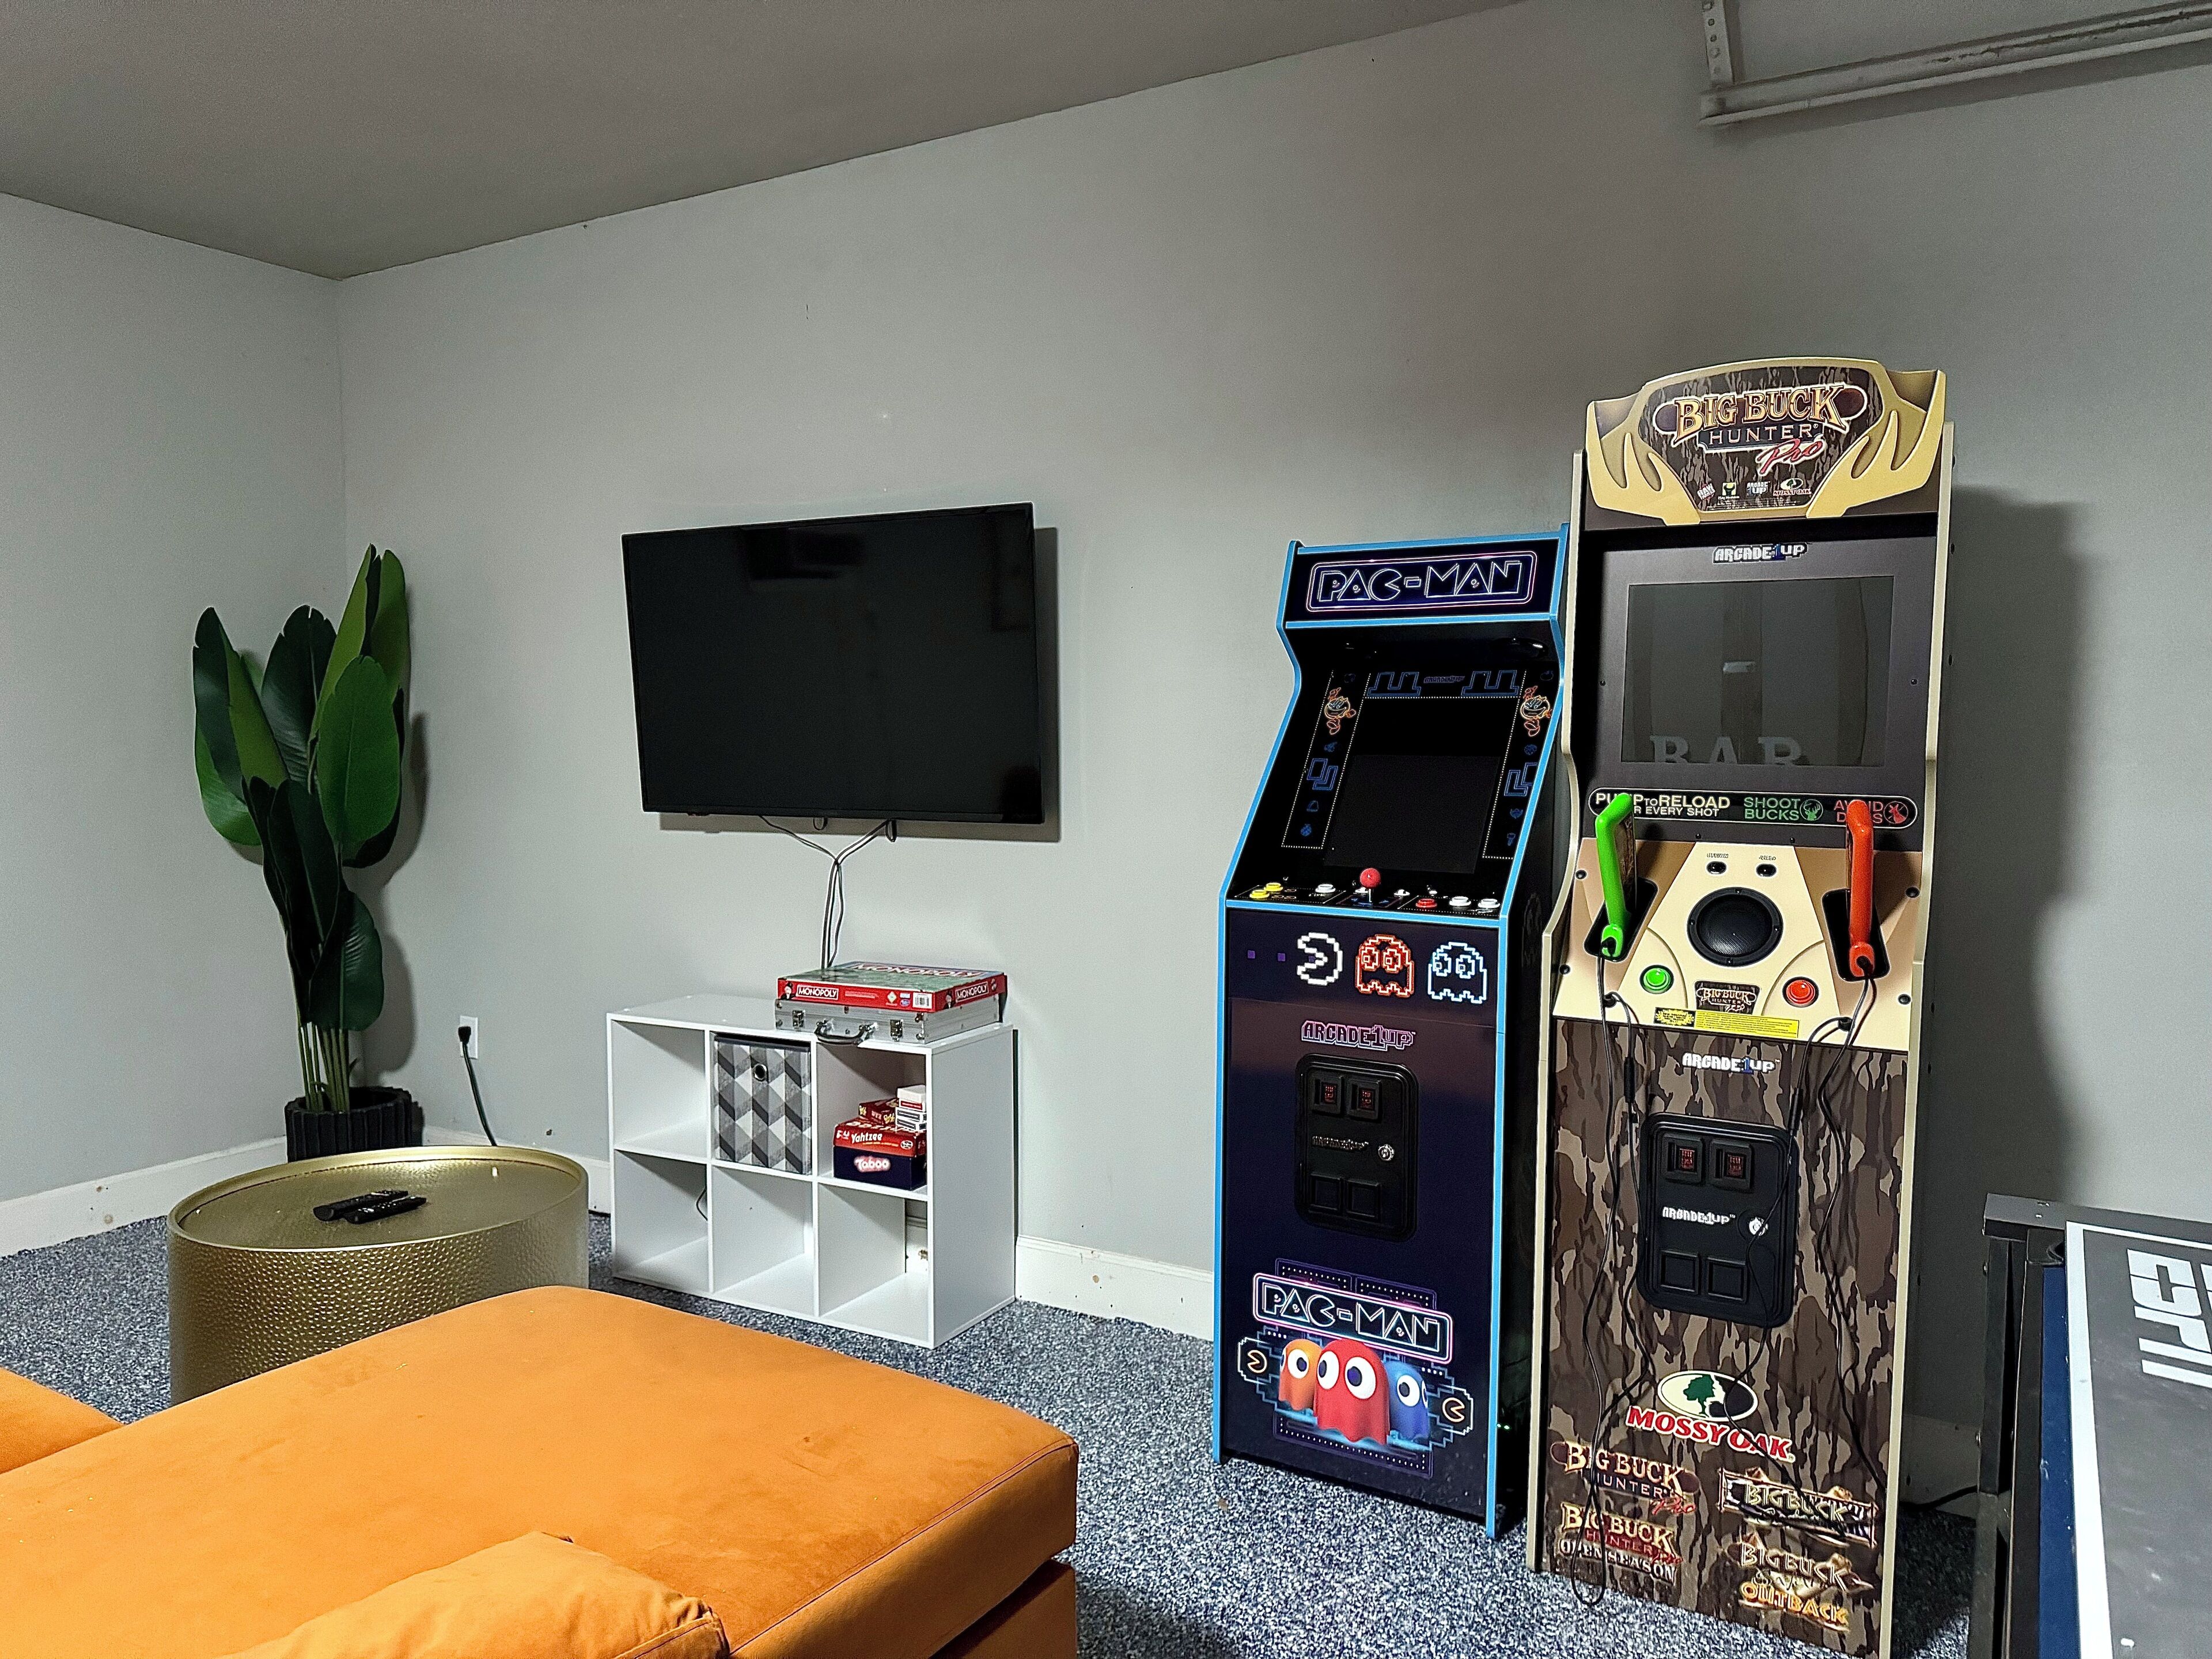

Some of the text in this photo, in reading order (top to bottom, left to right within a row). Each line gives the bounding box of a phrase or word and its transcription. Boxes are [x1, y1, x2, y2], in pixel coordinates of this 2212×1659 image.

[1673, 385, 1847, 444] BIG BUCK
[1709, 424, 1813, 445] HUNTER
[1758, 438, 1825, 475] Pro
[1317, 560, 1523, 602] PAC-MAN
[1659, 794, 1730, 809] RELOAD
[1744, 797, 1800, 809] SHOOT
[1646, 806, 1683, 816] EVERY
[1687, 808, 1719, 817] SHOT
[1745, 809, 1799, 820] BUCKS
[1836, 812, 1883, 823] DS
[853, 964, 986, 977] MONOPOLY
[798, 986, 838, 999] MONOPOLY
[956, 983, 988, 999] MONOPOLY
[1702, 988, 1750, 1003] BIG BUCK
[851, 1132, 883, 1143] Yahtzee
[855, 1157, 890, 1171] Taboo
[1262, 1282, 1440, 1352] PAC-MAN
[1627, 1406, 1792, 1459] MOSSY OAK
[1565, 1441, 1685, 1499] BIG BUCK
[1745, 1484, 1783, 1509] BIG
[1608, 1516, 1678, 1556] BUCK
[1741, 1543, 1779, 1568] BIG
[1785, 1553, 1849, 1592] BUCK
[1740, 1582, 1849, 1625] OUTBACK
